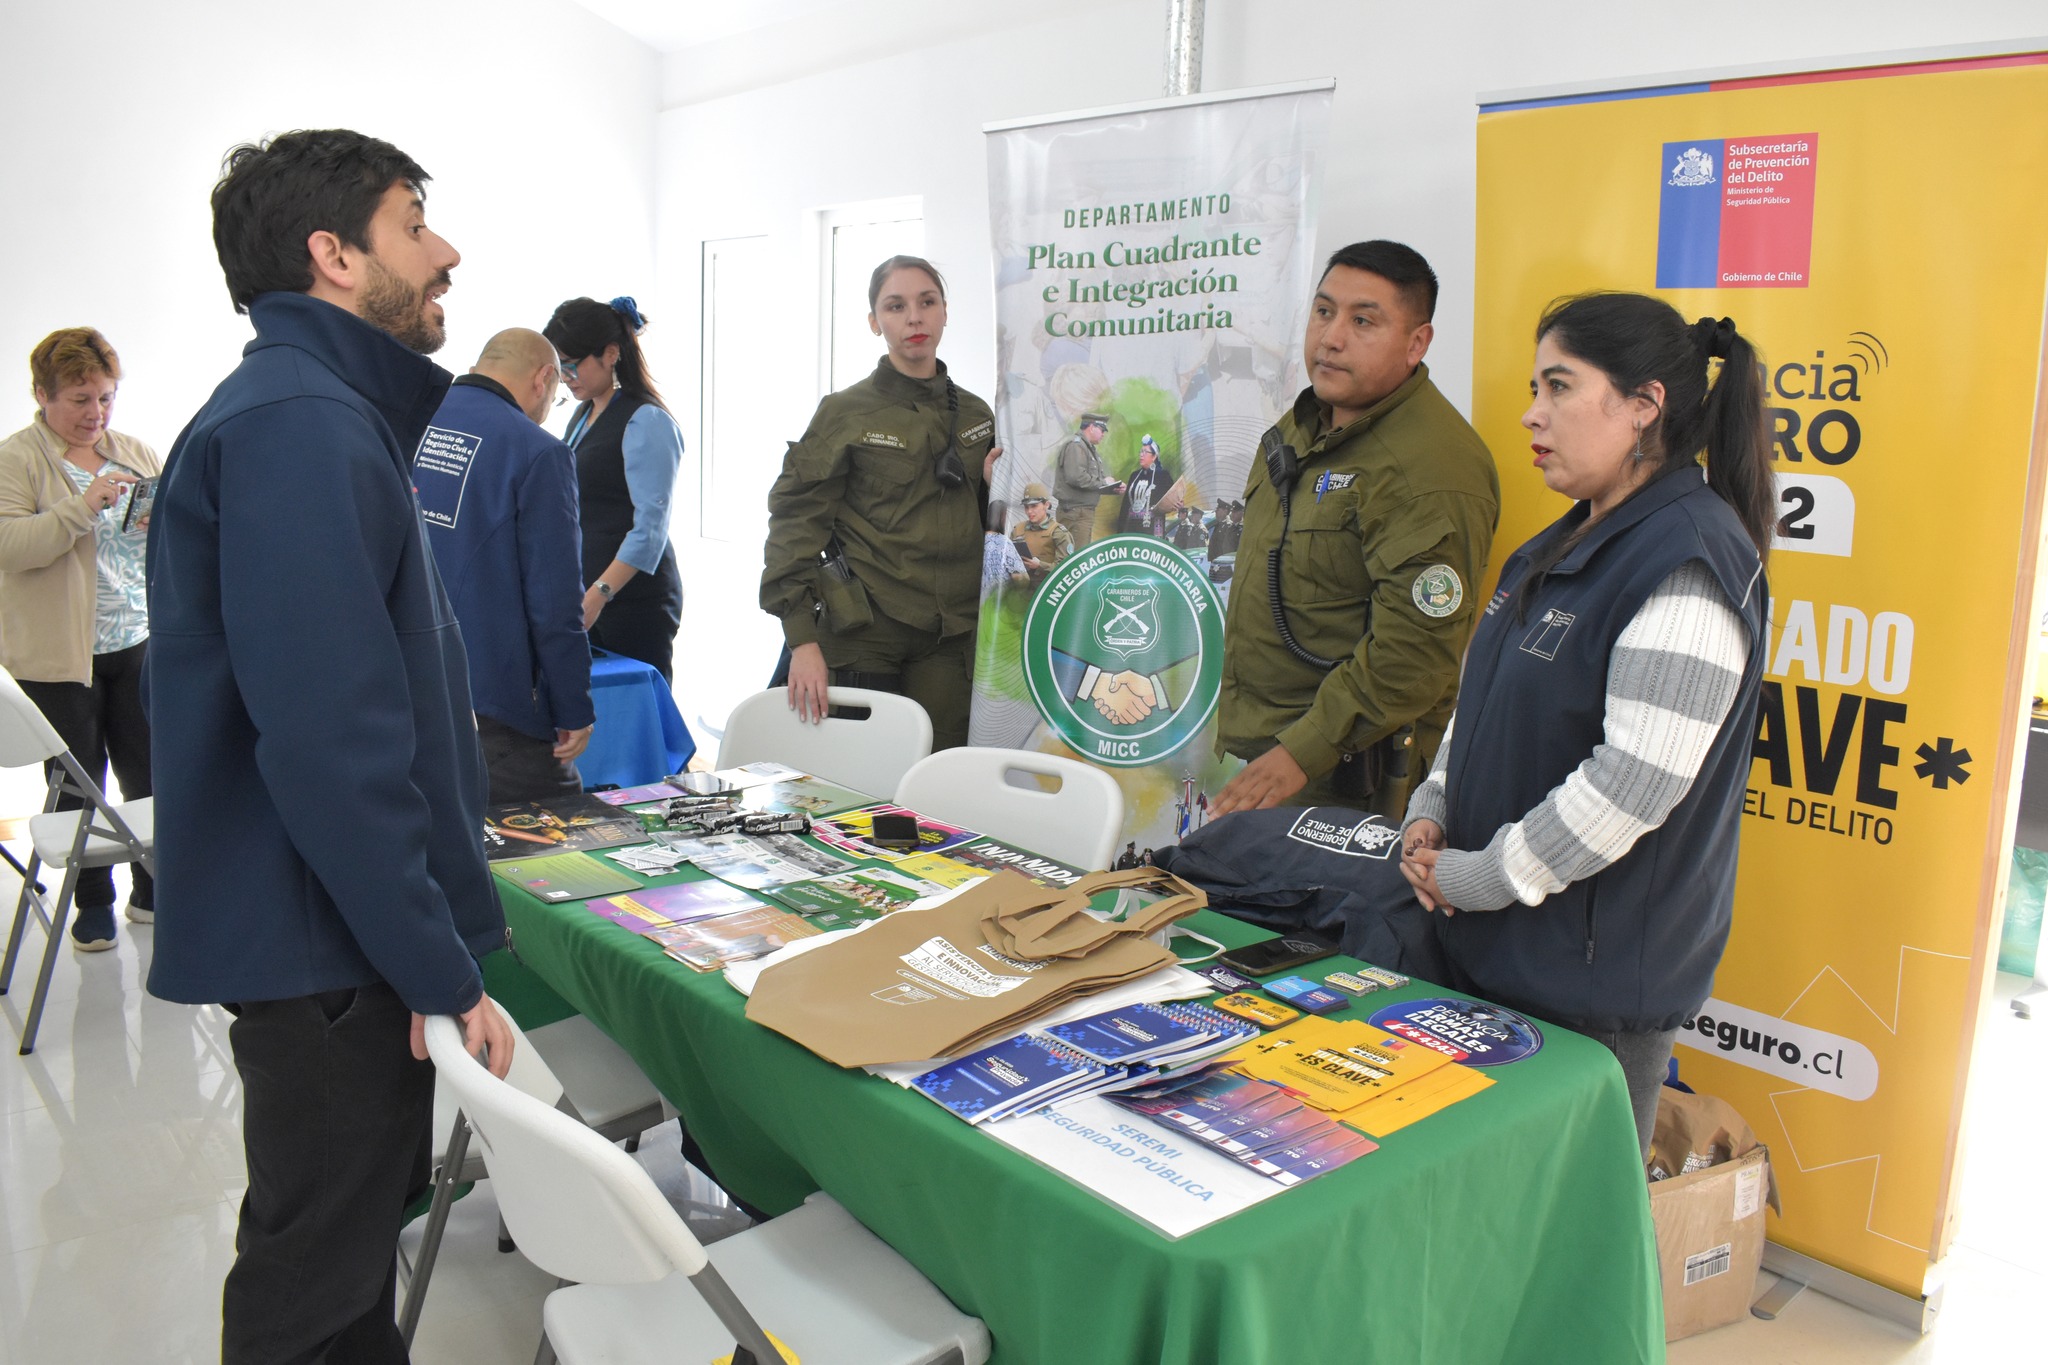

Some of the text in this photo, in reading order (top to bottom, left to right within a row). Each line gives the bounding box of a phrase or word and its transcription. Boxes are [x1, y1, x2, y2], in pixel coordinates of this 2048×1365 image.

[1729, 140, 1808, 156] Subsecretaría
[1728, 153, 1810, 171] de Prevención
[1727, 169, 1783, 184] del Delito
[1726, 186, 1774, 195] Ministerio de
[1063, 193, 1231, 229] DEPARTAMENTO
[1726, 195, 1790, 208] Seguridad Pública
[1027, 231, 1262, 270] Plan Cuadrante
[1722, 271, 1803, 282] Gobierno de Chile
[1042, 267, 1239, 307] e Integración
[1044, 302, 1234, 338] Comunitaria
[425, 438, 451, 450] Registro
[451, 444, 468, 454] Civil
[429, 431, 465, 444] Servicio de
[422, 446, 468, 463] Identificación
[436, 512, 452, 522] Chile
[1046, 546, 1208, 613] INTEGRACIÓN COMUNITARIA
[1106, 588, 1142, 596] CARABINEROS
[1097, 739, 1140, 758] MICC
[1304, 818, 1352, 837] DE CHILE
[1786, 797, 1894, 846] DELITO
[1297, 826, 1347, 846] GOBIERNO
[922, 956, 933, 965] AL
[935, 939, 989, 977] ASISTENCIA
[936, 952, 946, 960] E
[1404, 1012, 1492, 1052] ILEGALES
[1417, 1009, 1484, 1038] ARMAS
[1431, 1004, 1509, 1041] DENUNCIA
[1300, 1054, 1325, 1066] ES
[1328, 1055, 1386, 1079] LLAMADO
[1111, 1123, 1183, 1160] SEREMI
[1035, 1105, 1215, 1202] SEGURIDAD PÚBLICA
